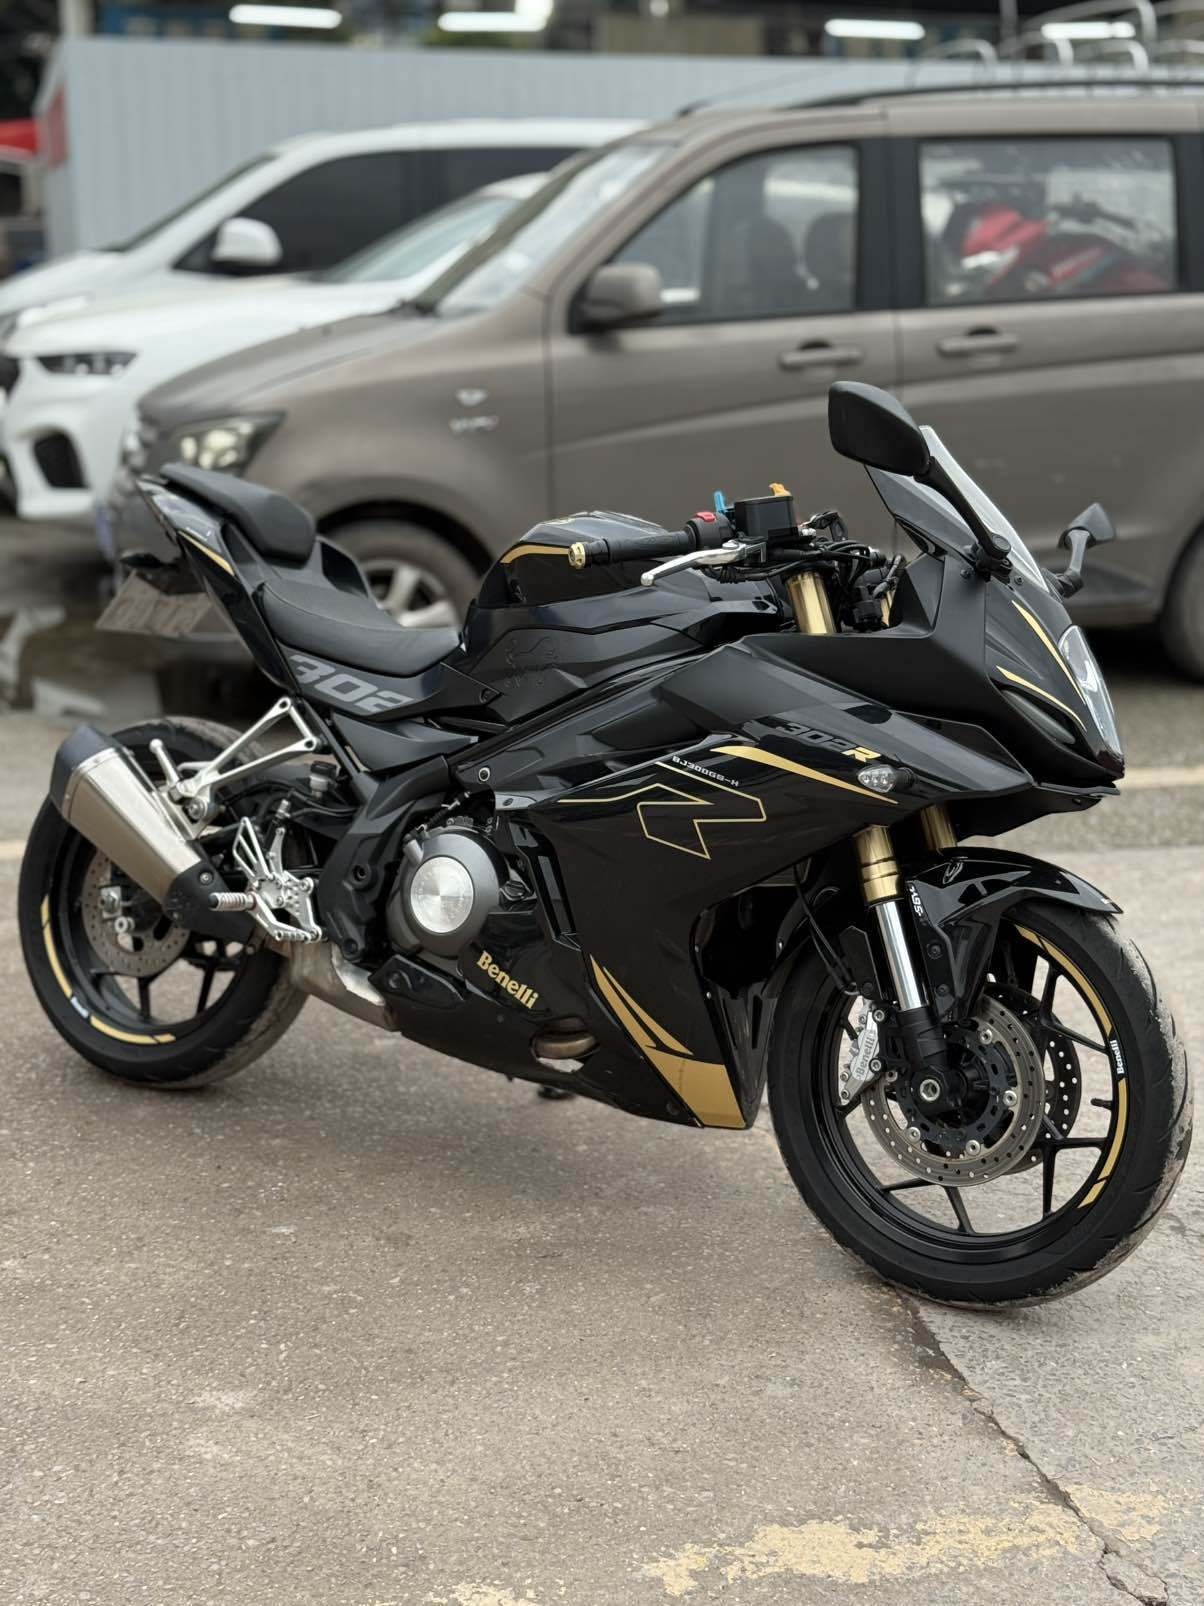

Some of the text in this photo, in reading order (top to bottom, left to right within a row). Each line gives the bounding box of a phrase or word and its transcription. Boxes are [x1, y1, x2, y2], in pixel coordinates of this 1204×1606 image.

[289, 655, 415, 712] 302
[476, 950, 539, 1010] Benelli
[855, 1034, 876, 1077] Benelli
[1110, 1040, 1125, 1074] Benelli
